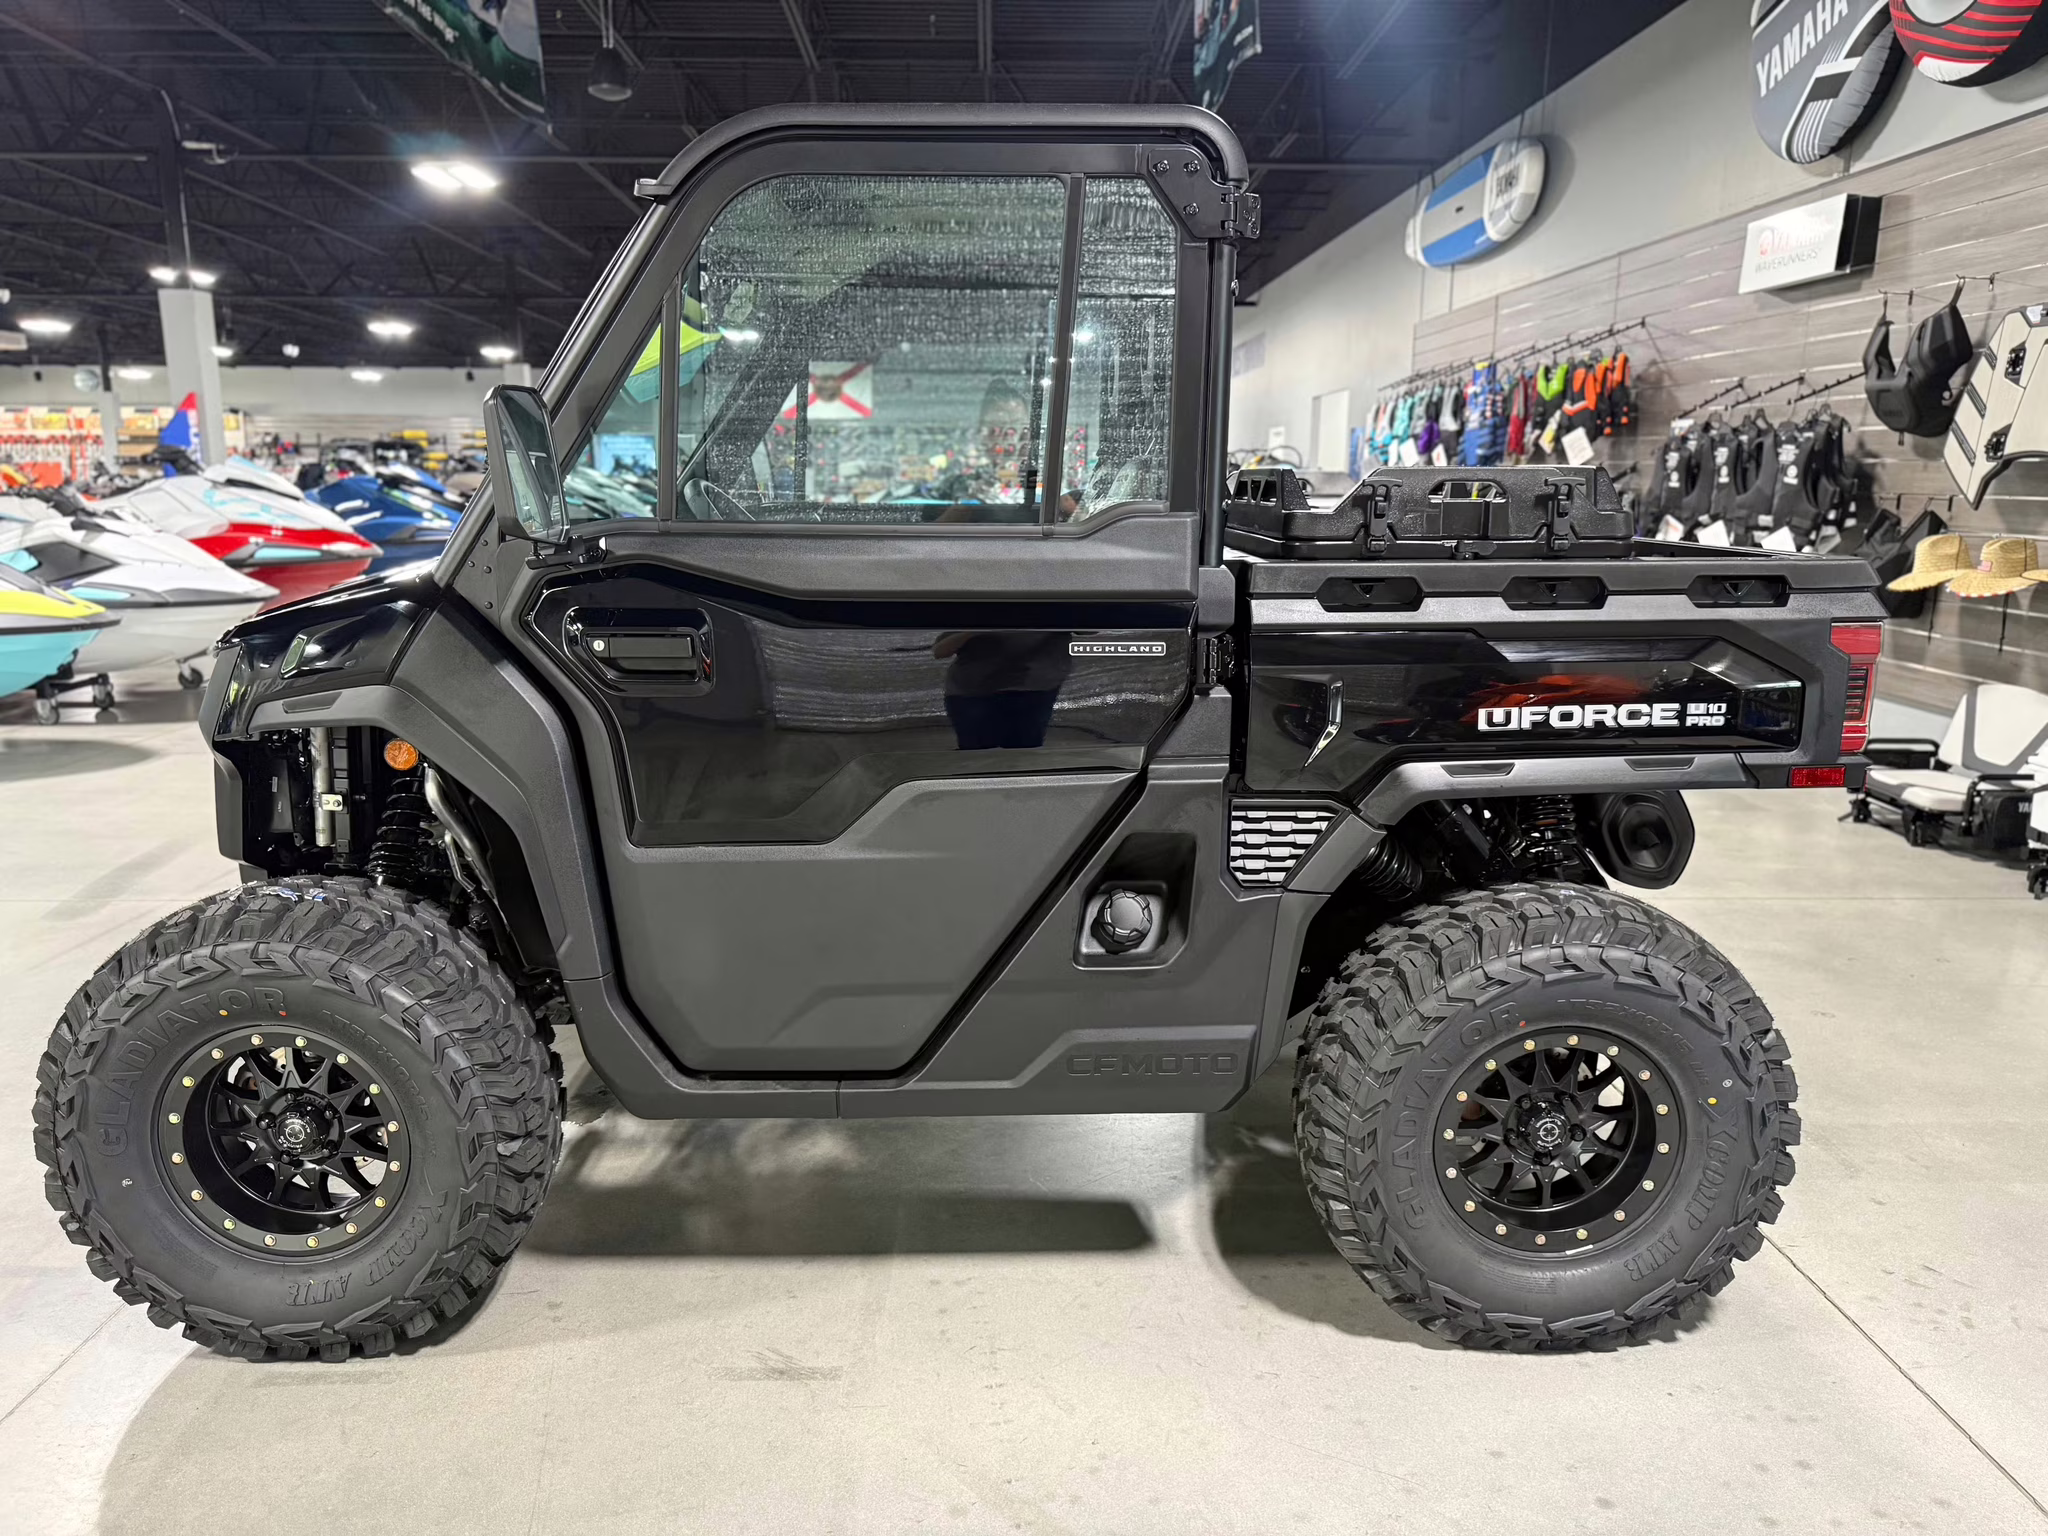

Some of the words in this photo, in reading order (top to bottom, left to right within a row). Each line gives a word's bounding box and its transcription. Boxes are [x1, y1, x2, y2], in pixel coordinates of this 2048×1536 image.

[1756, 0, 1848, 98] YAMAHA
[1072, 644, 1163, 654] HIGHLAND
[1478, 703, 1680, 731] UFORCE
[1685, 715, 1726, 727] PRO
[1687, 703, 1727, 715] U10
[95, 987, 286, 1156] GLADIATOR
[1066, 1053, 1239, 1076] CFMOTO
[1392, 1002, 1522, 1229] GLADIATOR
